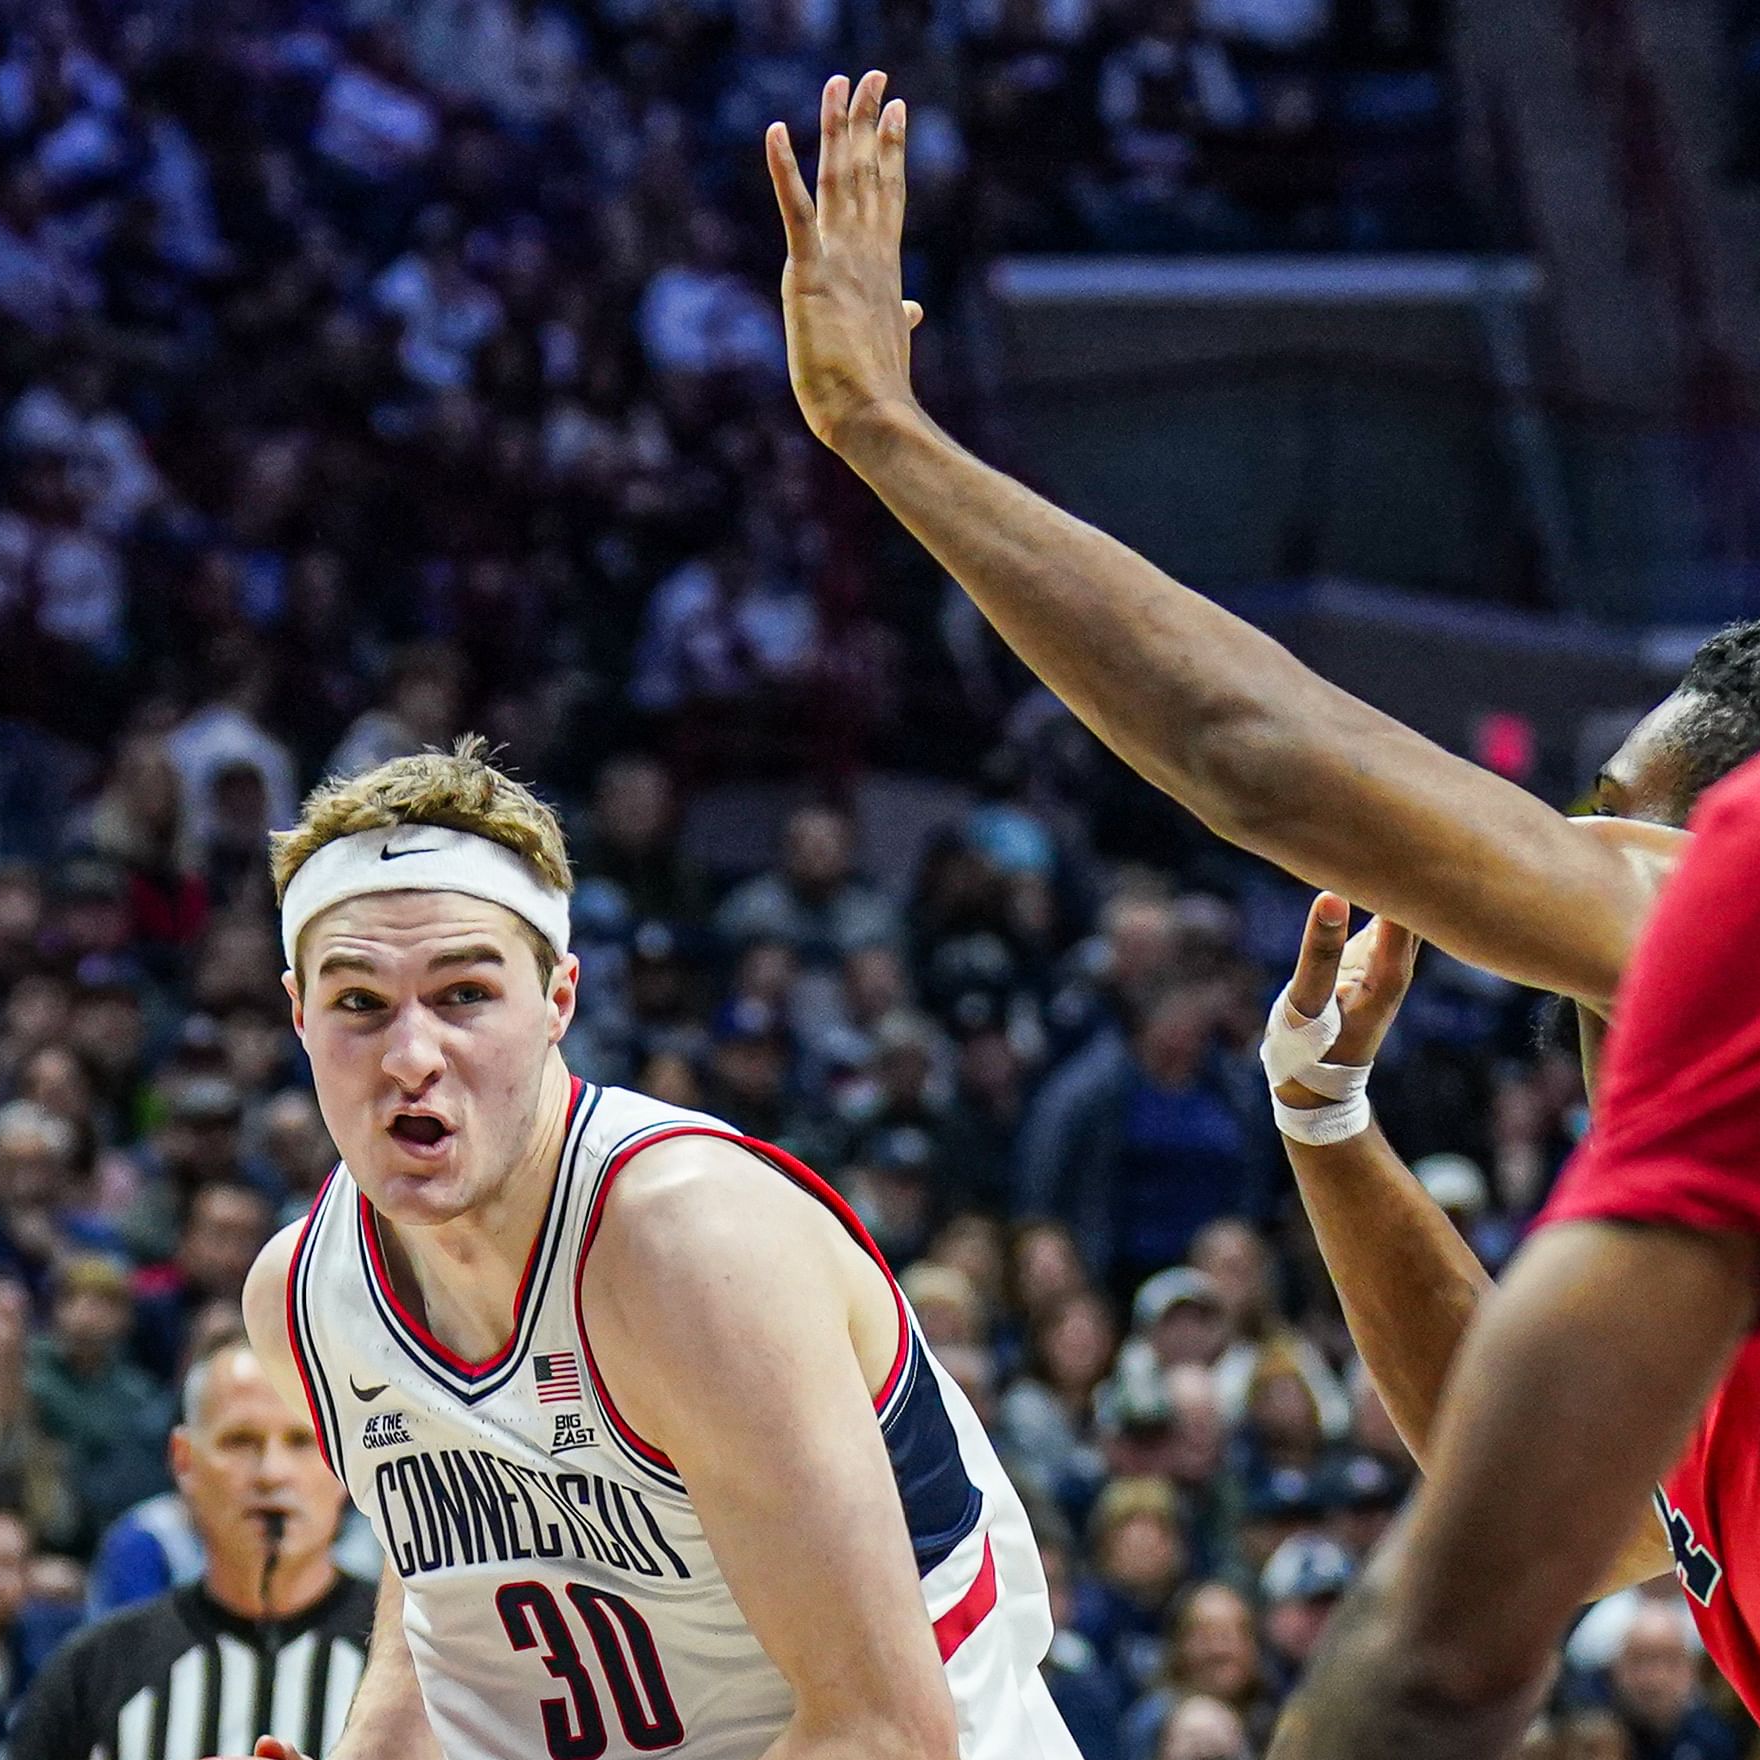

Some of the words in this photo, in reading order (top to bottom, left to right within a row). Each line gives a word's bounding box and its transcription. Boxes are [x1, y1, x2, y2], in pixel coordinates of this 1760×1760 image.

[365, 1414, 379, 1433] BE
[382, 1413, 403, 1431] THE
[555, 1413, 581, 1430] BIG
[362, 1430, 413, 1449] CHANGE
[552, 1428, 596, 1447] EAST
[376, 1449, 691, 1578] CONNECTICUT
